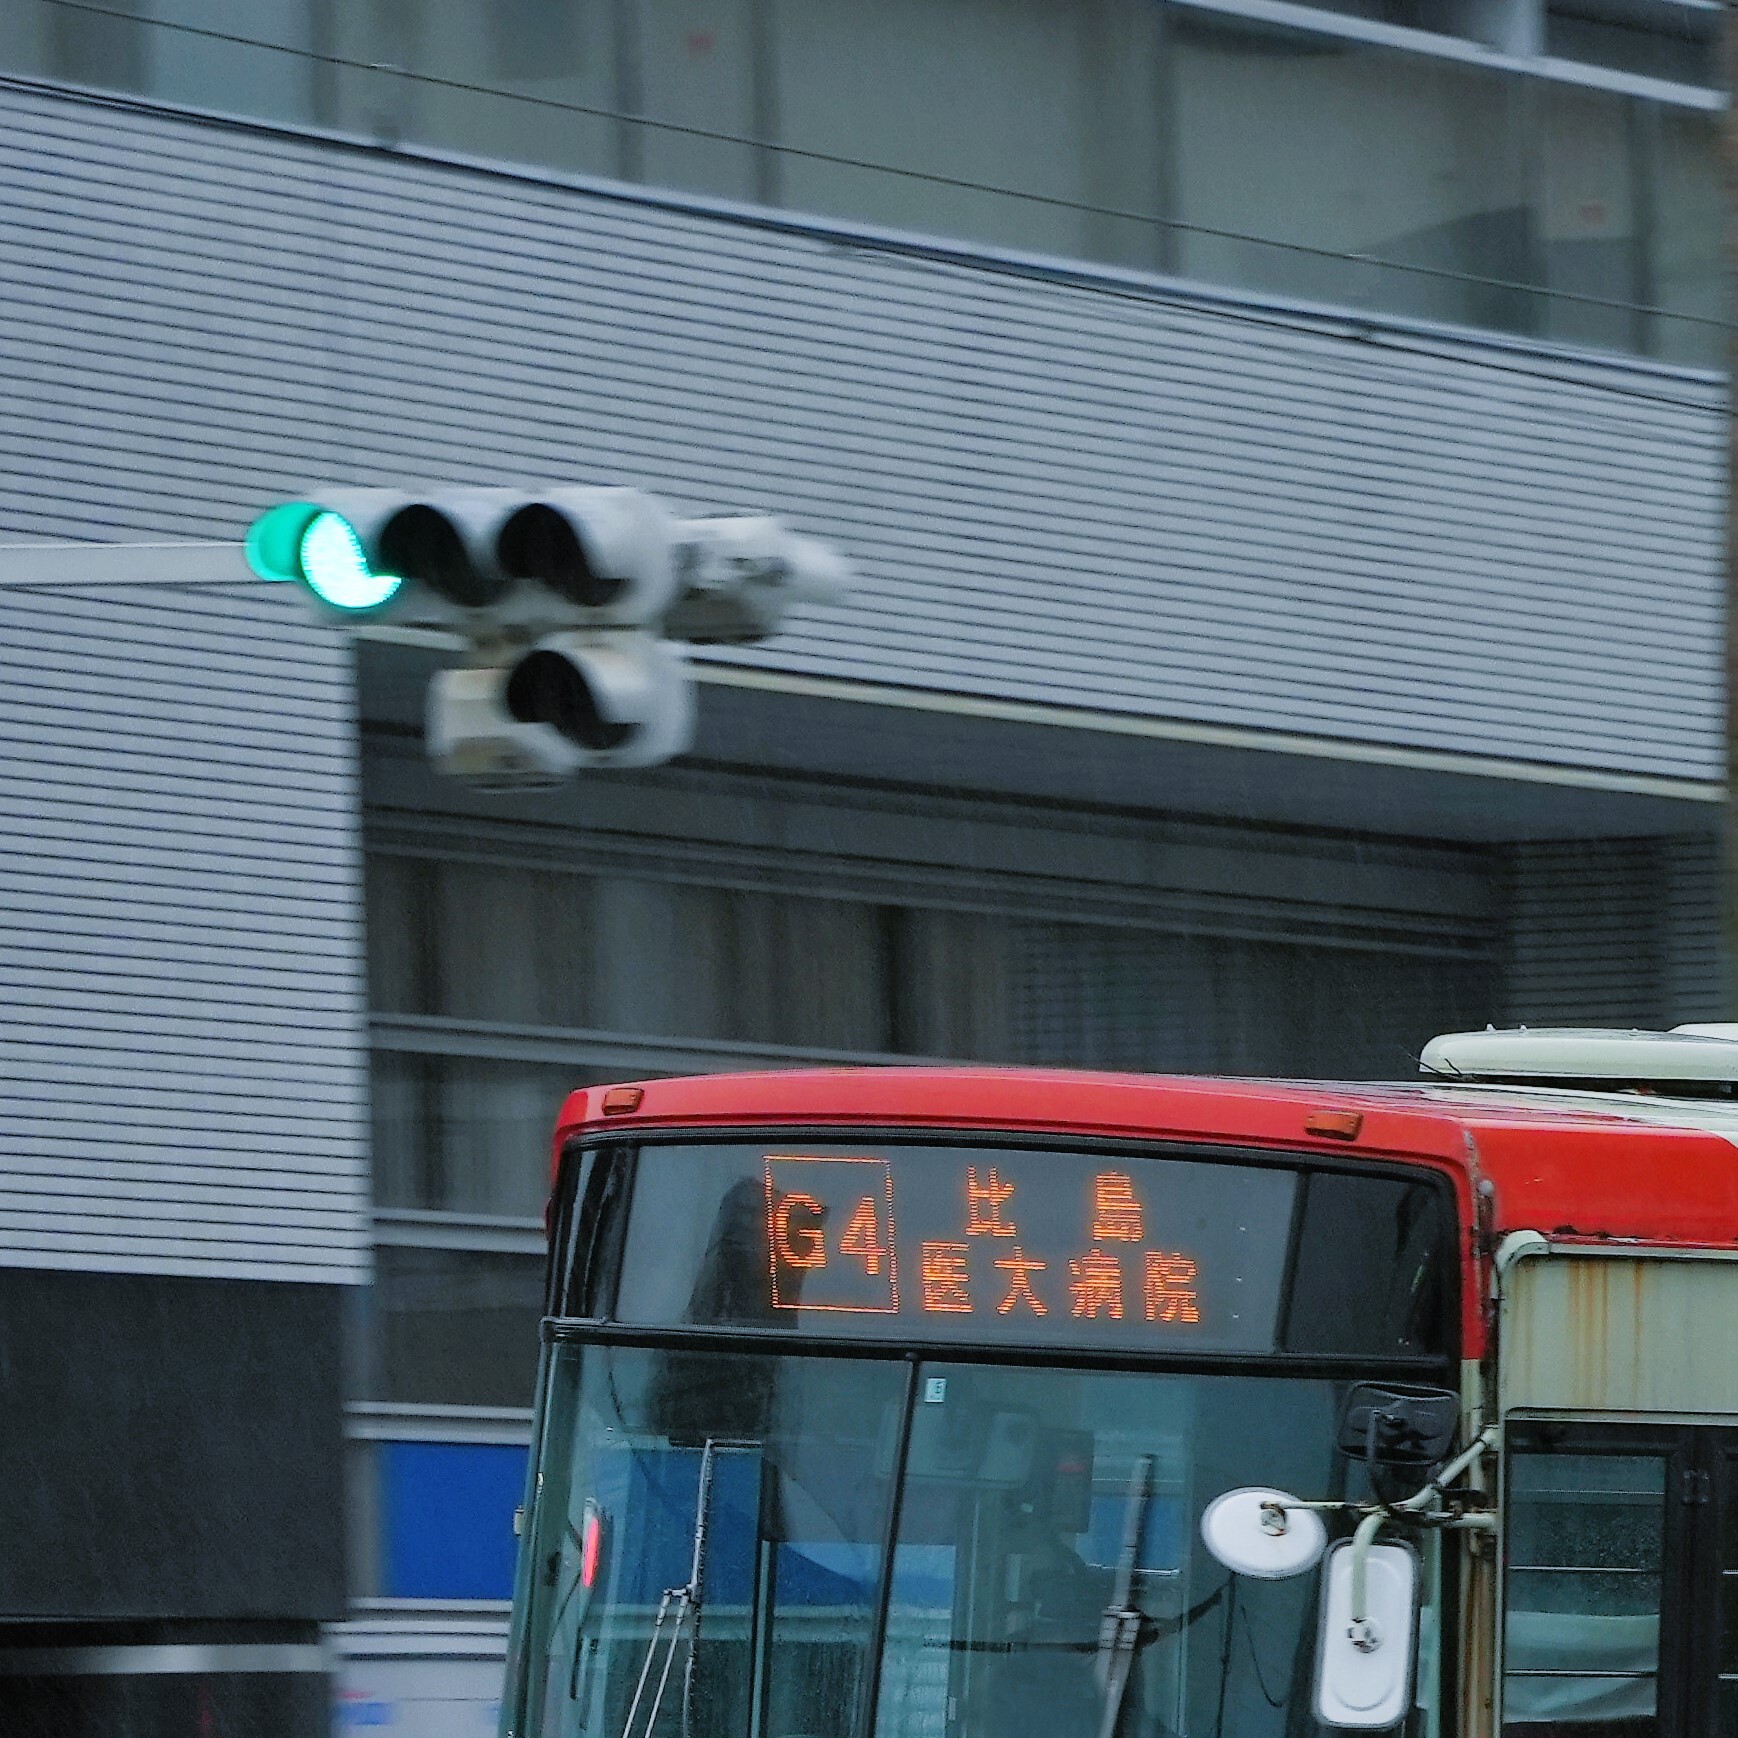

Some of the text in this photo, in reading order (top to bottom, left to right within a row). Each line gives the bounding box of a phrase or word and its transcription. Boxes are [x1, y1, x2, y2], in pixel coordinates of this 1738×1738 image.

[772, 1192, 889, 1276] G4
[921, 1240, 1200, 1324] 医大病院
